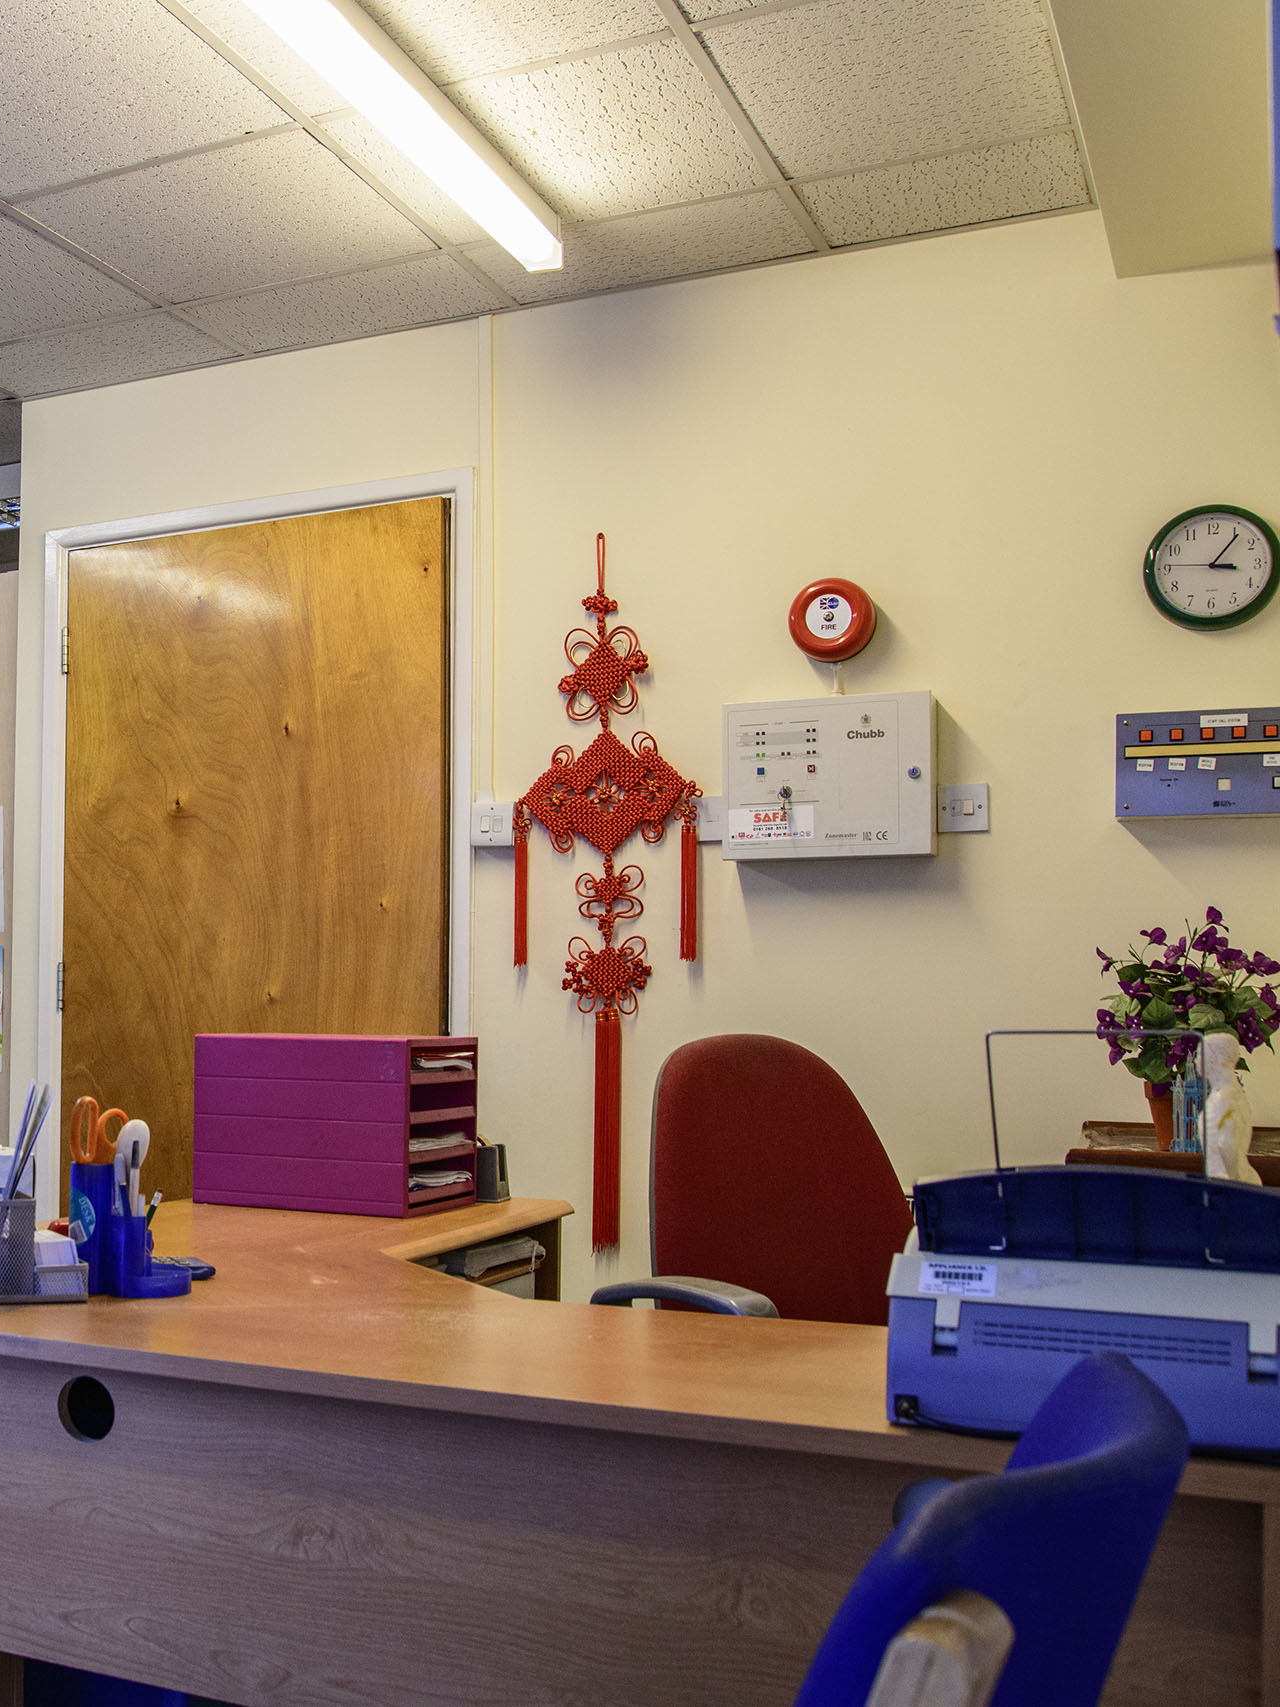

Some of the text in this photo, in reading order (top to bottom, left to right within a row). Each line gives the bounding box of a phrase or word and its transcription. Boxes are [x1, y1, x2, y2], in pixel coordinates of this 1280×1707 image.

[1186, 529, 1196, 541] 11
[1207, 523, 1220, 535] 12
[1169, 544, 1181, 556] 10
[1247, 538, 1255, 550] 2
[1164, 564, 1171, 575] 9
[1254, 558, 1261, 570] 3
[1171, 580, 1178, 592] 8
[1246, 577, 1253, 588] 4
[1187, 595, 1194, 607] 7
[1207, 597, 1215, 609] 6
[1229, 592, 1237, 604] 5
[847, 729, 885, 739] Chubb
